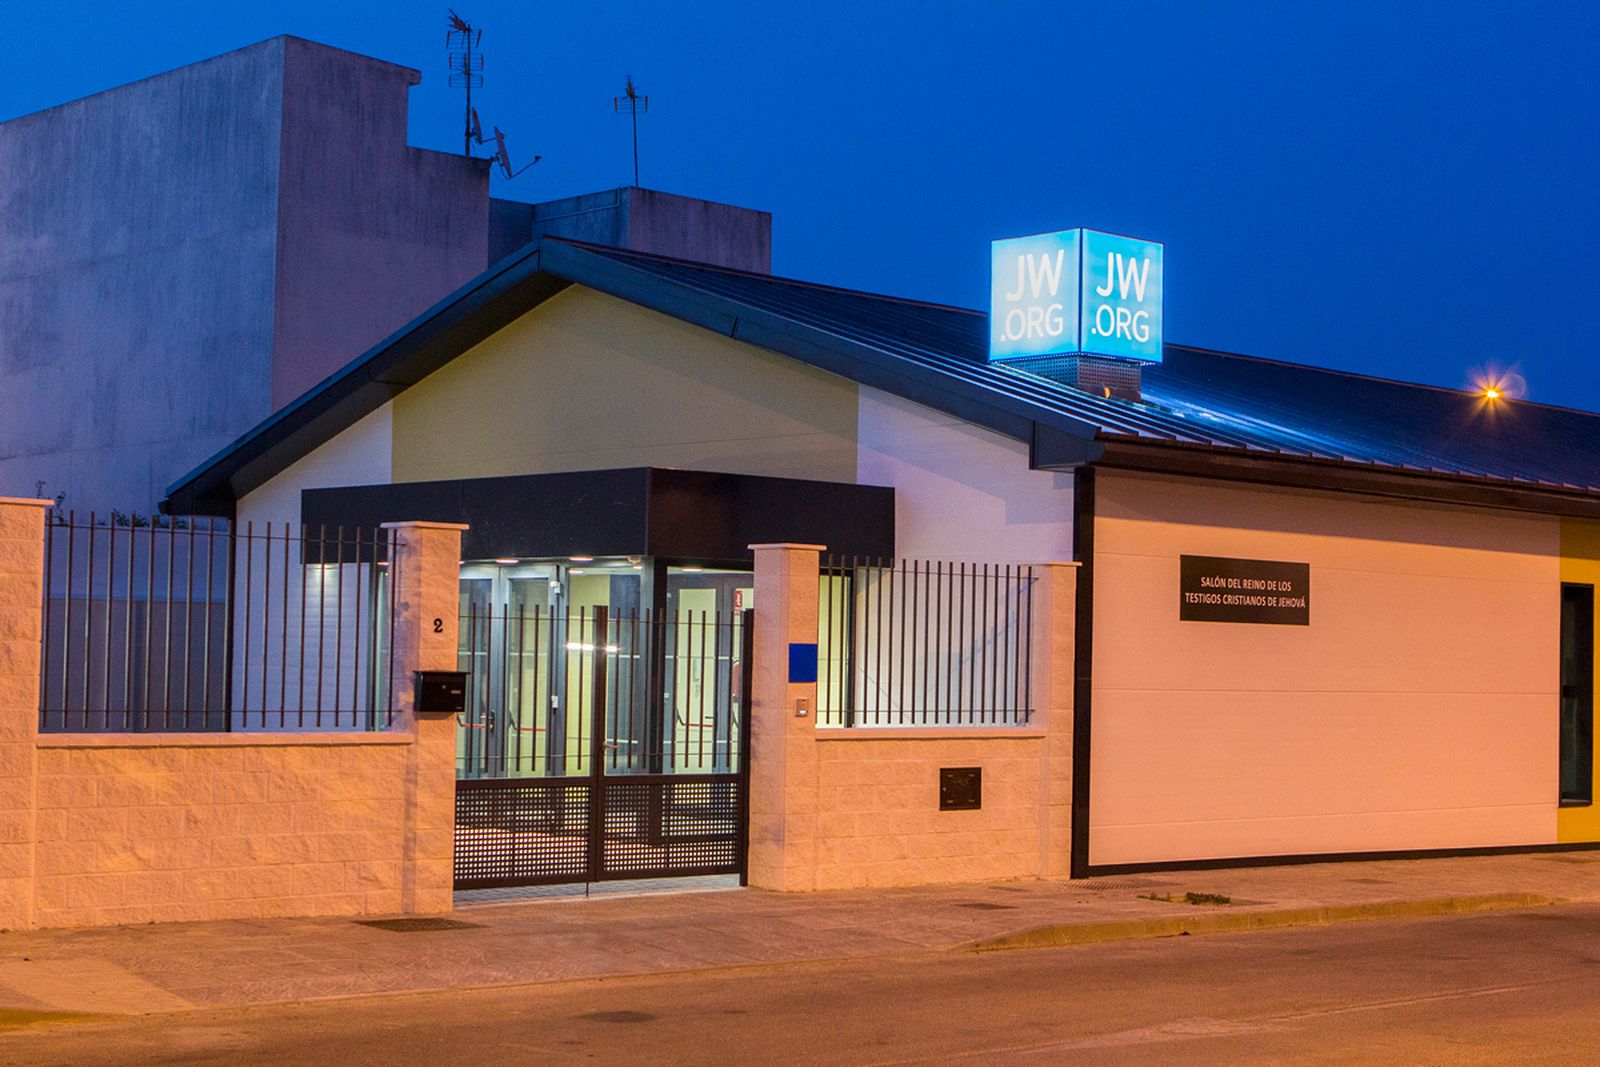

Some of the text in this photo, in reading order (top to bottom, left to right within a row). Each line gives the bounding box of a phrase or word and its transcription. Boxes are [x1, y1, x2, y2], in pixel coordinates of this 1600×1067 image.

[1006, 249, 1065, 301] JW
[1096, 251, 1150, 302] JW
[1000, 303, 1064, 342] .ORG
[1091, 303, 1150, 343] .ORG
[1185, 592, 1306, 608] TESTIGOS CRISTIANOS DE JEHOVÁ
[1200, 575, 1292, 591] SALÓN DEL REINO DE LOS
[433, 618, 443, 633] 2
